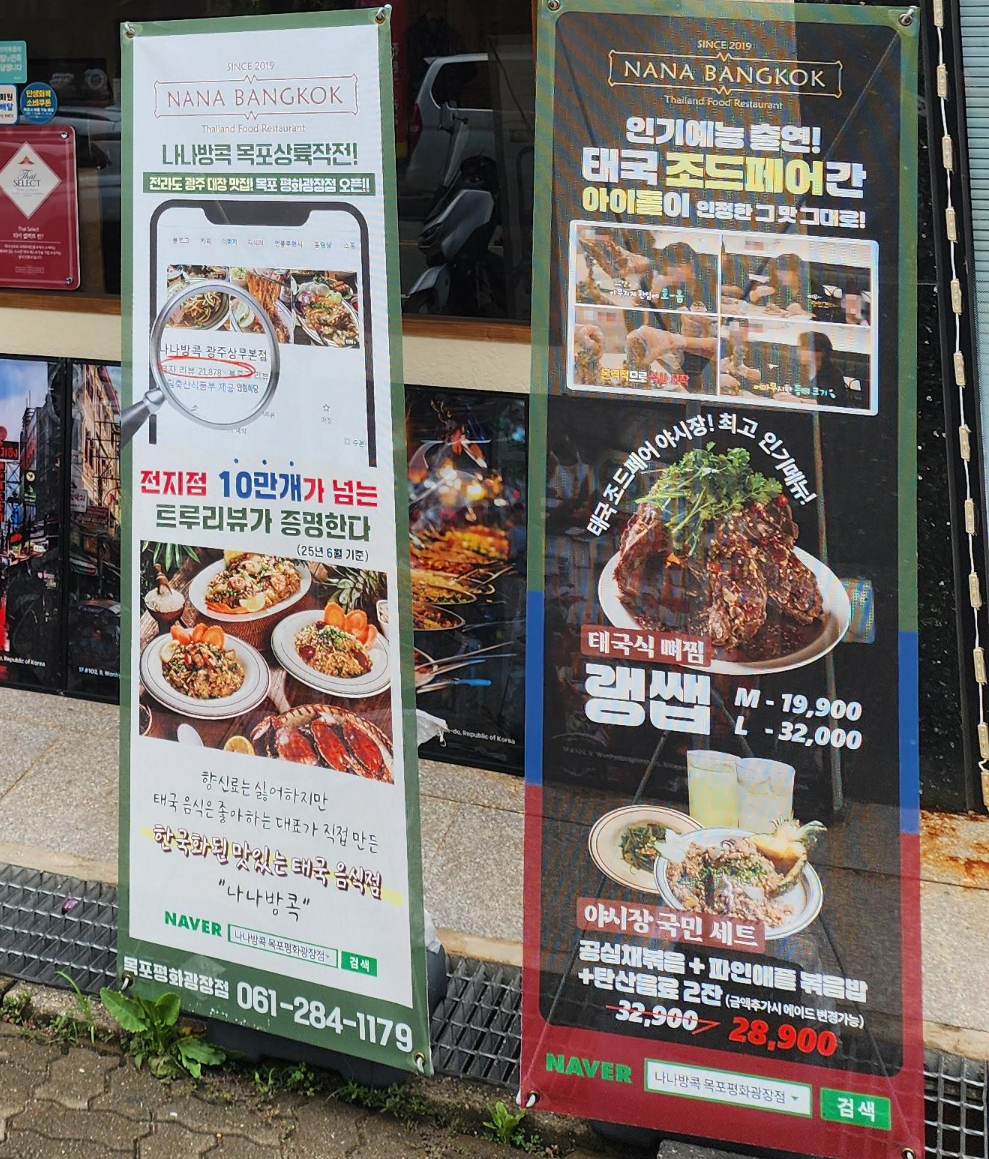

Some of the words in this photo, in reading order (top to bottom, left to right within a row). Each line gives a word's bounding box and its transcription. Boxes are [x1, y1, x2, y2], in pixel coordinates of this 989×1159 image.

[697, 40, 728, 51] SINCE
[729, 41, 753, 51] 2019
[226, 61, 252, 72] SINCE
[254, 60, 275, 71] 2019
[623, 60, 695, 81] NANA
[704, 65, 826, 88] BANGKOK
[167, 89, 226, 108] NANA
[235, 86, 344, 107] BANGKOK
[664, 95, 705, 107] Thailand
[707, 96, 732, 107] Food
[734, 98, 783, 111] Restaurant
[201, 124, 236, 134] Thailand
[238, 123, 259, 133] Food
[261, 123, 306, 133] Restaurant
[626, 116, 745, 151] 인기예능
[749, 122, 822, 155] 출연!
[162, 143, 232, 166] 나나방콕
[236, 142, 358, 166] 목포상륙작전!
[582, 146, 659, 186] 태국
[13, 179, 41, 188] SELECT
[149, 177, 183, 192] 전라도
[184, 177, 205, 192] 광주
[207, 177, 227, 192] 대장
[229, 177, 254, 192] 맛집!
[255, 178, 278, 192] 목포
[279, 177, 337, 193] 평화광장점
[582, 186, 690, 218] 아이돌이
[696, 199, 755, 221] 인정한
[755, 205, 776, 223] 그
[778, 205, 797, 226] 맛
[799, 207, 866, 229] 그대로!
[179, 365, 195, 376] 리뷰
[586, 500, 618, 537] 태국
[654, 413, 714, 450] 야시장!
[718, 412, 758, 440] 최고
[758, 431, 817, 506] 인기메뉴!
[140, 470, 207, 497] 전지점
[219, 470, 325, 504] 10만개가
[332, 478, 378, 508] 넘는
[156, 503, 272, 534] 트루리뷰가
[280, 509, 371, 542] 증명한다
[297, 544, 323, 560] (25년
[345, 547, 369, 563] 기준)
[588, 630, 655, 659] 태국식
[660, 636, 705, 665] 뼈찜
[734, 687, 761, 709] M
[781, 693, 863, 722] 19,900
[462, 729, 488, 740] Republic
[496, 733, 516, 745] Korea
[734, 715, 748, 736] L
[202, 771, 250, 797] 향신료는
[153, 792, 179, 813] 태국
[183, 796, 214, 819] 음식은
[217, 801, 271, 829] 좋아하는
[275, 817, 318, 835] 대표가
[323, 822, 348, 847] 직접
[352, 831, 379, 854] 만든
[232, 841, 288, 877] 맛있는
[291, 857, 330, 886] 태국
[334, 861, 382, 900] 음식점
[164, 910, 223, 938] NAVER
[234, 929, 267, 947] 나나방콕
[584, 903, 654, 935] 야시장
[656, 912, 704, 943] 국민
[708, 920, 760, 948] 세트
[349, 956, 371, 973] 검색
[579, 939, 687, 976] 공심채볶음
[708, 957, 797, 993] 파인애플
[800, 968, 869, 1004] 볶음밥
[123, 955, 230, 1000] 목포평화광장점
[236, 981, 413, 1053] 061-284-1179
[578, 965, 680, 1000] +탄산음료
[682, 979, 724, 1007] 2잔
[724, 992, 782, 1017] (금액추가시
[783, 1001, 816, 1021] 에이드
[816, 1007, 865, 1030] 변경가능)
[615, 999, 698, 1031] 32,900
[727, 1016, 839, 1058] 28,900
[545, 1052, 632, 1085] NAVER
[654, 1071, 701, 1092] 나나방콕
[703, 1078, 787, 1104] 목포평화광장점
[836, 1097, 876, 1122] 검색
